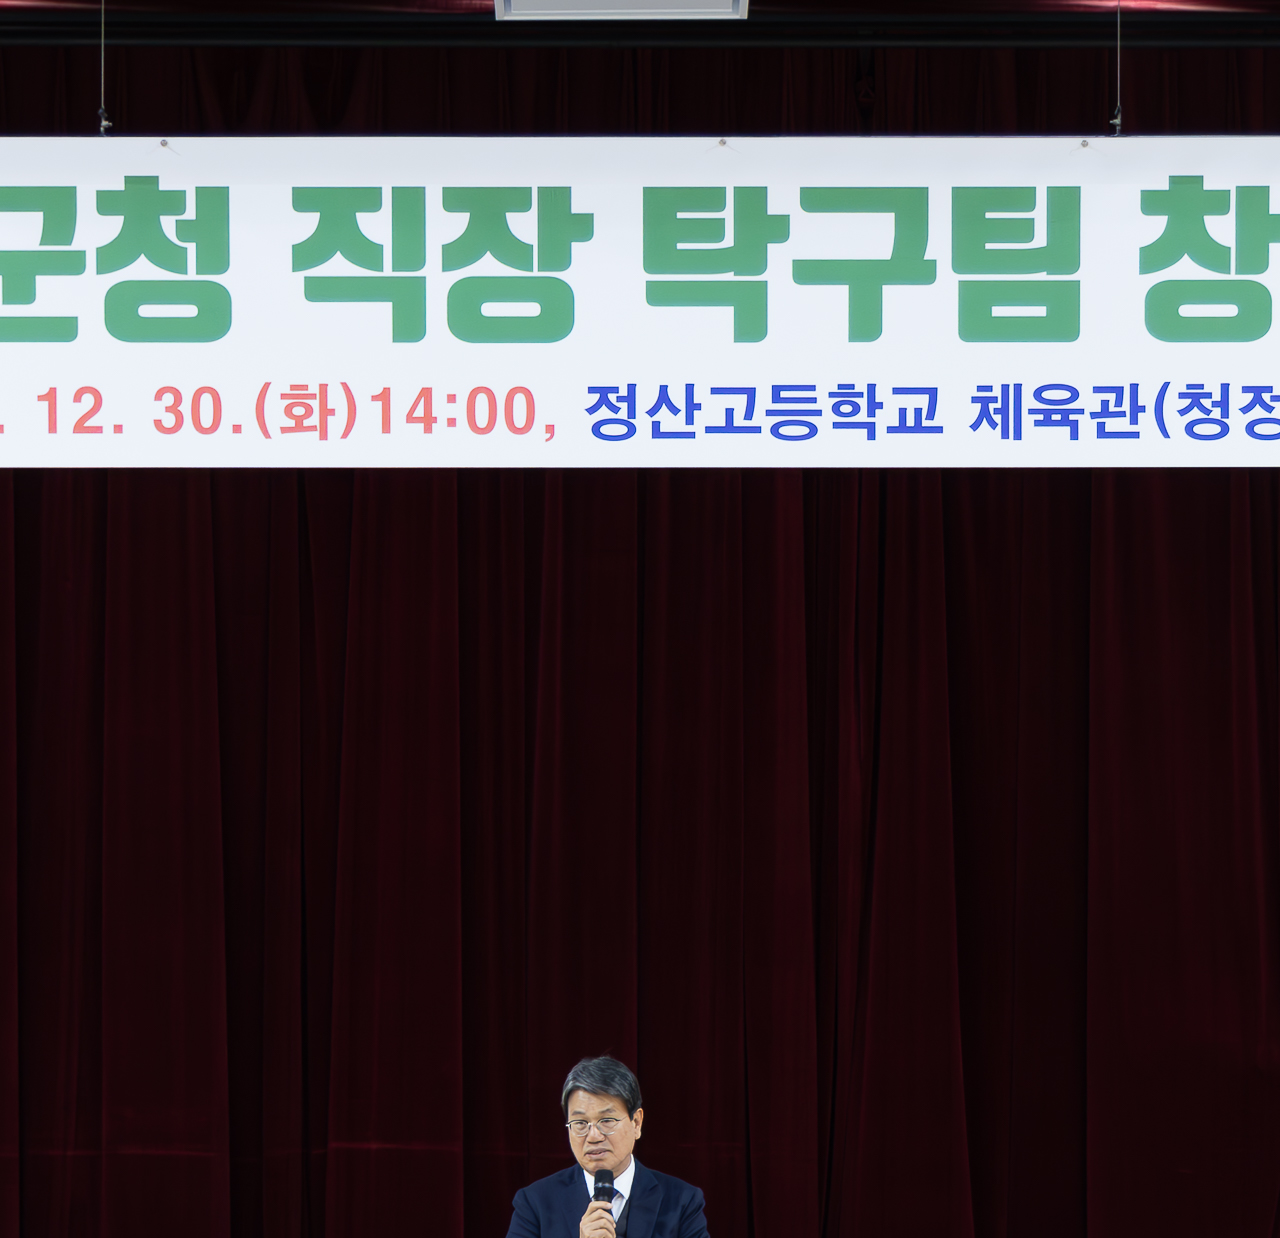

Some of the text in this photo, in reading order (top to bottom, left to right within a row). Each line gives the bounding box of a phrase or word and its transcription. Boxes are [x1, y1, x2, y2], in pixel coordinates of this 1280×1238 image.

[291, 186, 595, 344] 직장
[642, 186, 1082, 343] 탁구팀
[37, 385, 124, 434] 12.
[584, 382, 944, 442] 정산고등학교
